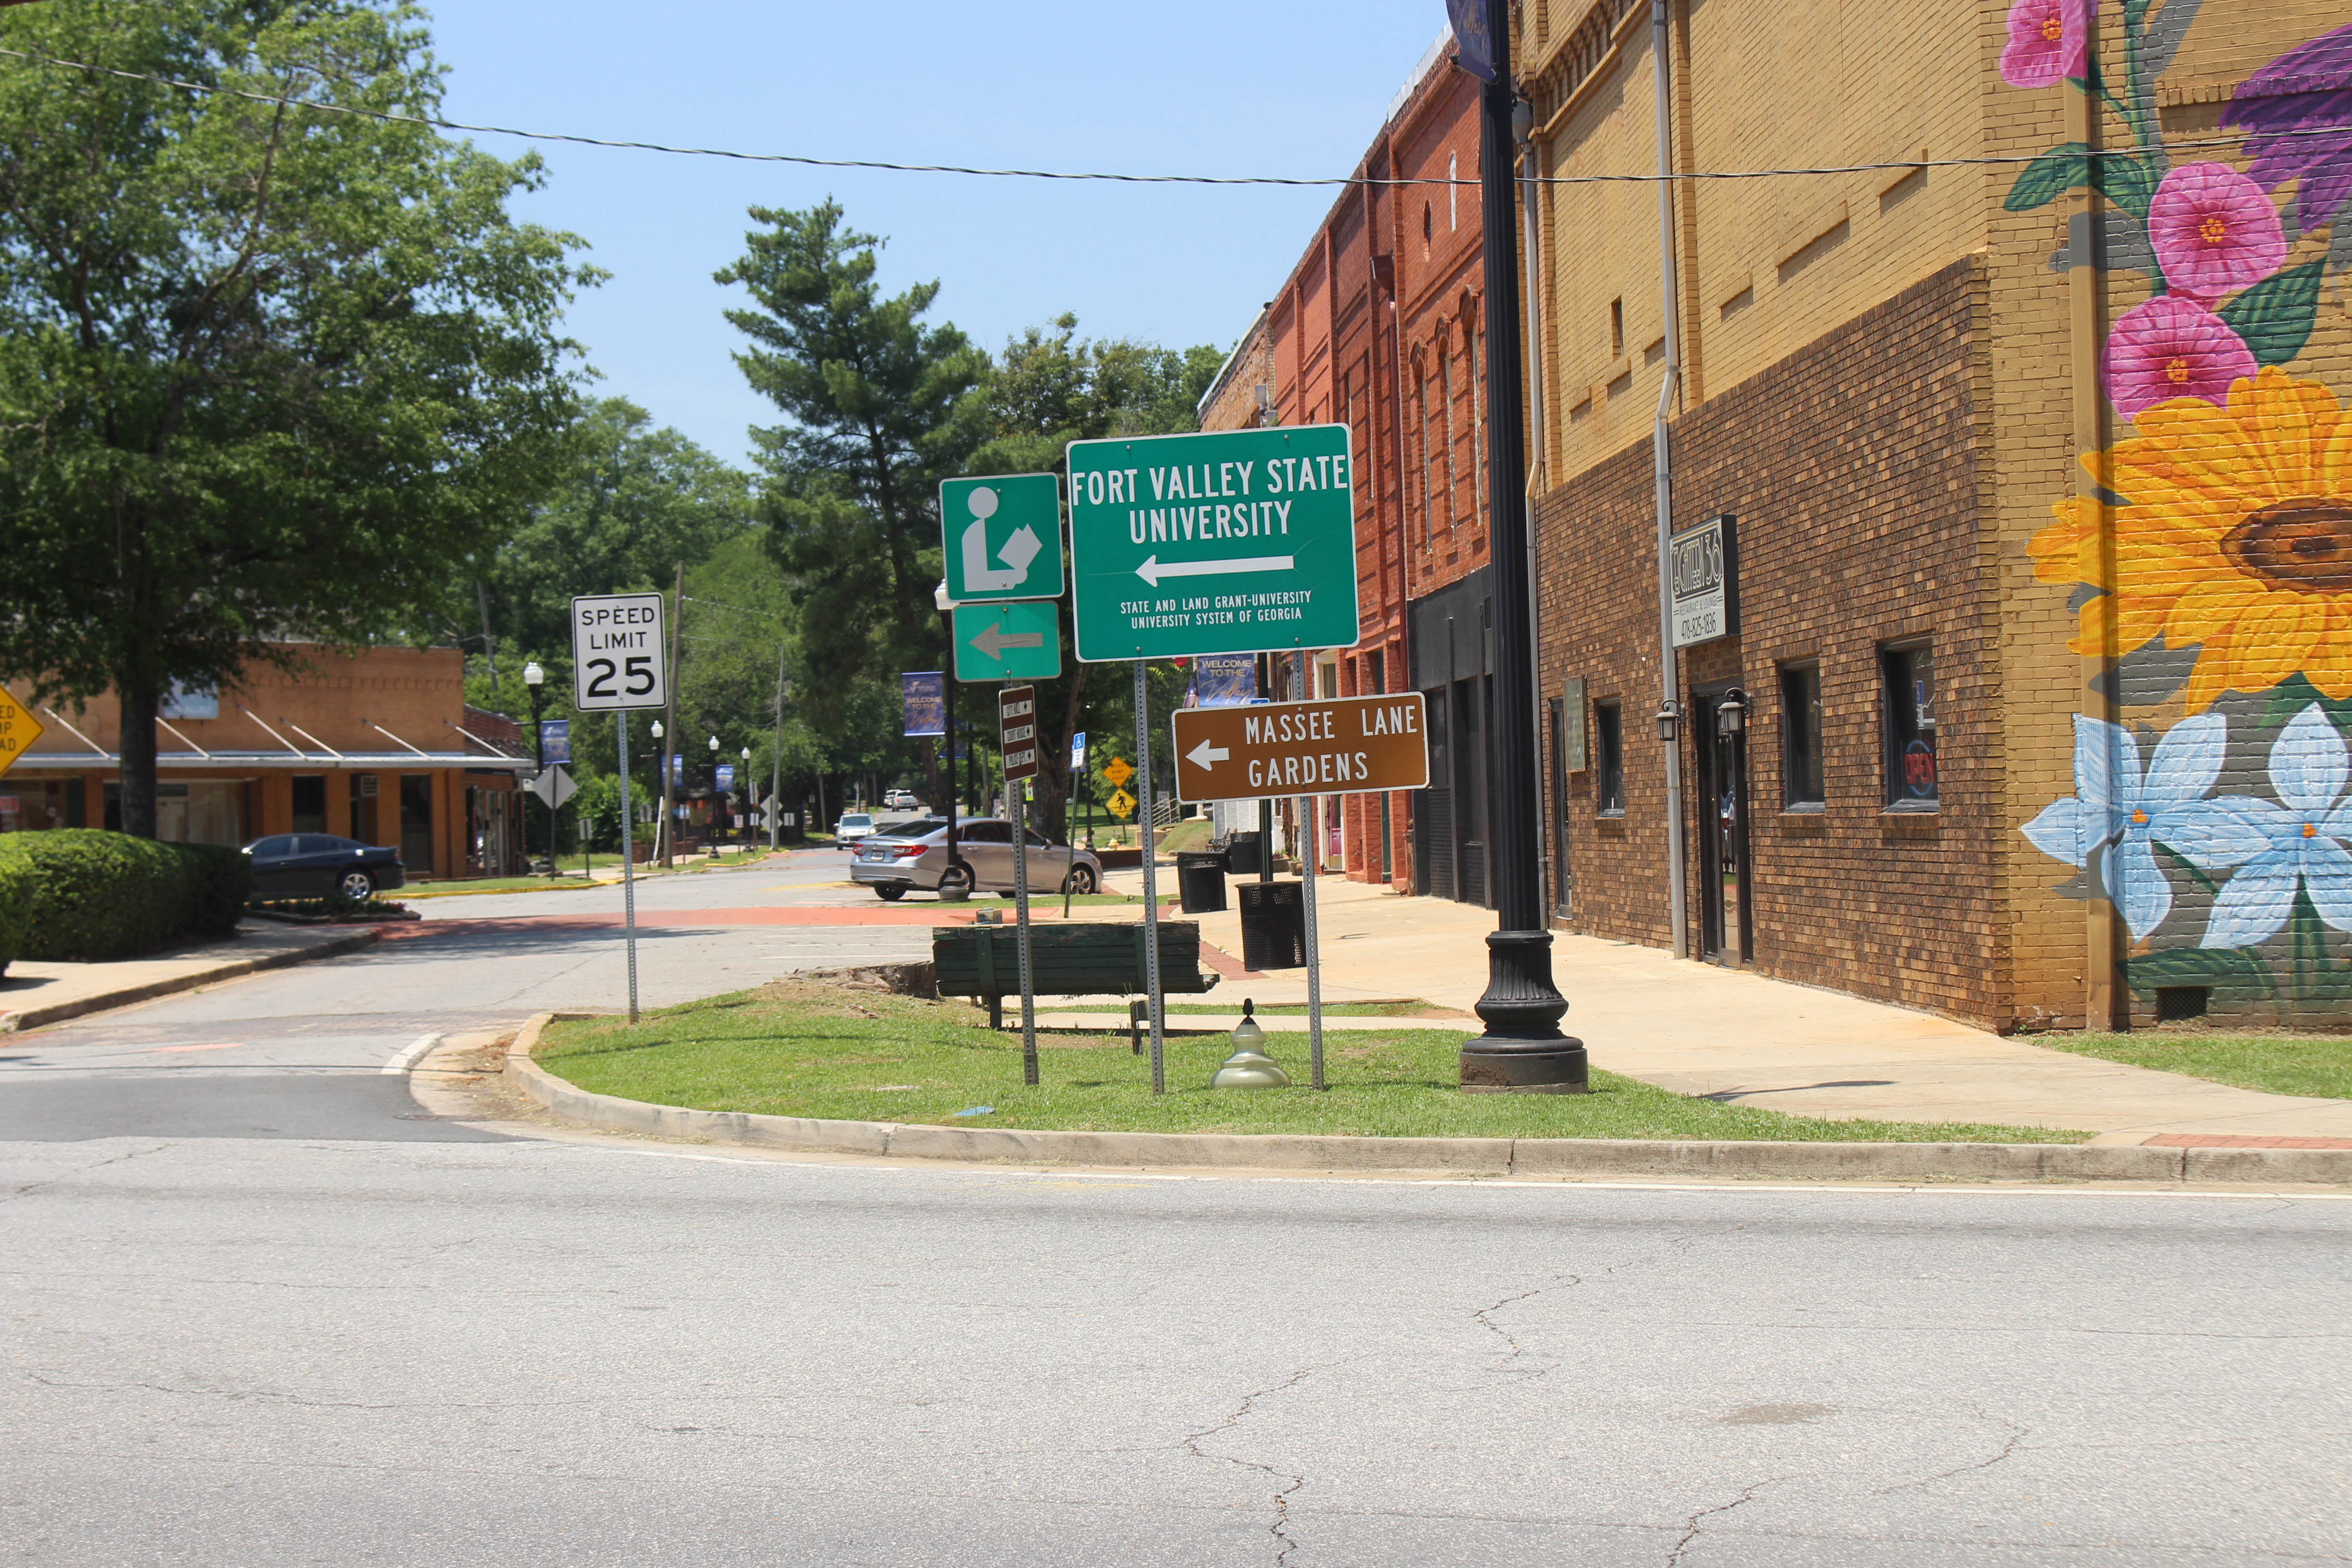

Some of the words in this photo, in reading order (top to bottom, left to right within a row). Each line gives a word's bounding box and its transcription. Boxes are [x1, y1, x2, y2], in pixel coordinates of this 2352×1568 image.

[1072, 469, 1138, 506] FORT
[1149, 461, 1254, 500] VALLEY
[1267, 455, 1348, 493] STATE
[1129, 500, 1292, 544] UNIVERSITY
[1671, 536, 1705, 595] EIGHTEEN
[1705, 531, 1721, 585] 36
[582, 608, 654, 625] SPEED
[1120, 600, 1149, 614] STATE
[1155, 599, 1176, 612] AND
[1182, 597, 1209, 611] LAND
[1215, 591, 1311, 608] GRANT-UNIVERSITY
[1680, 603, 1698, 616] RESTAURANT
[1704, 596, 1716, 608] LOUNGE
[1132, 614, 1190, 629] UNIVERSITY
[1196, 612, 1234, 625] SYSTEM
[1240, 610, 1252, 622] OF
[1258, 607, 1302, 622] GEORGIA
[1681, 612, 1716, 640] 478-825-1836
[591, 632, 647, 649] LIMIT
[586, 656, 655, 697] 25
[1202, 660, 1252, 668] WELCOME
[1201, 677, 1251, 705] Valley
[1007, 729, 1016, 742] COURT
[1017, 726, 1026, 739] HOUSE
[1245, 711, 1335, 744] MASSEE
[1361, 705, 1417, 736] LANE
[1009, 753, 1019, 766] POLICE
[1249, 752, 1368, 788] GARDENS
[1905, 753, 1936, 784] OPEN
